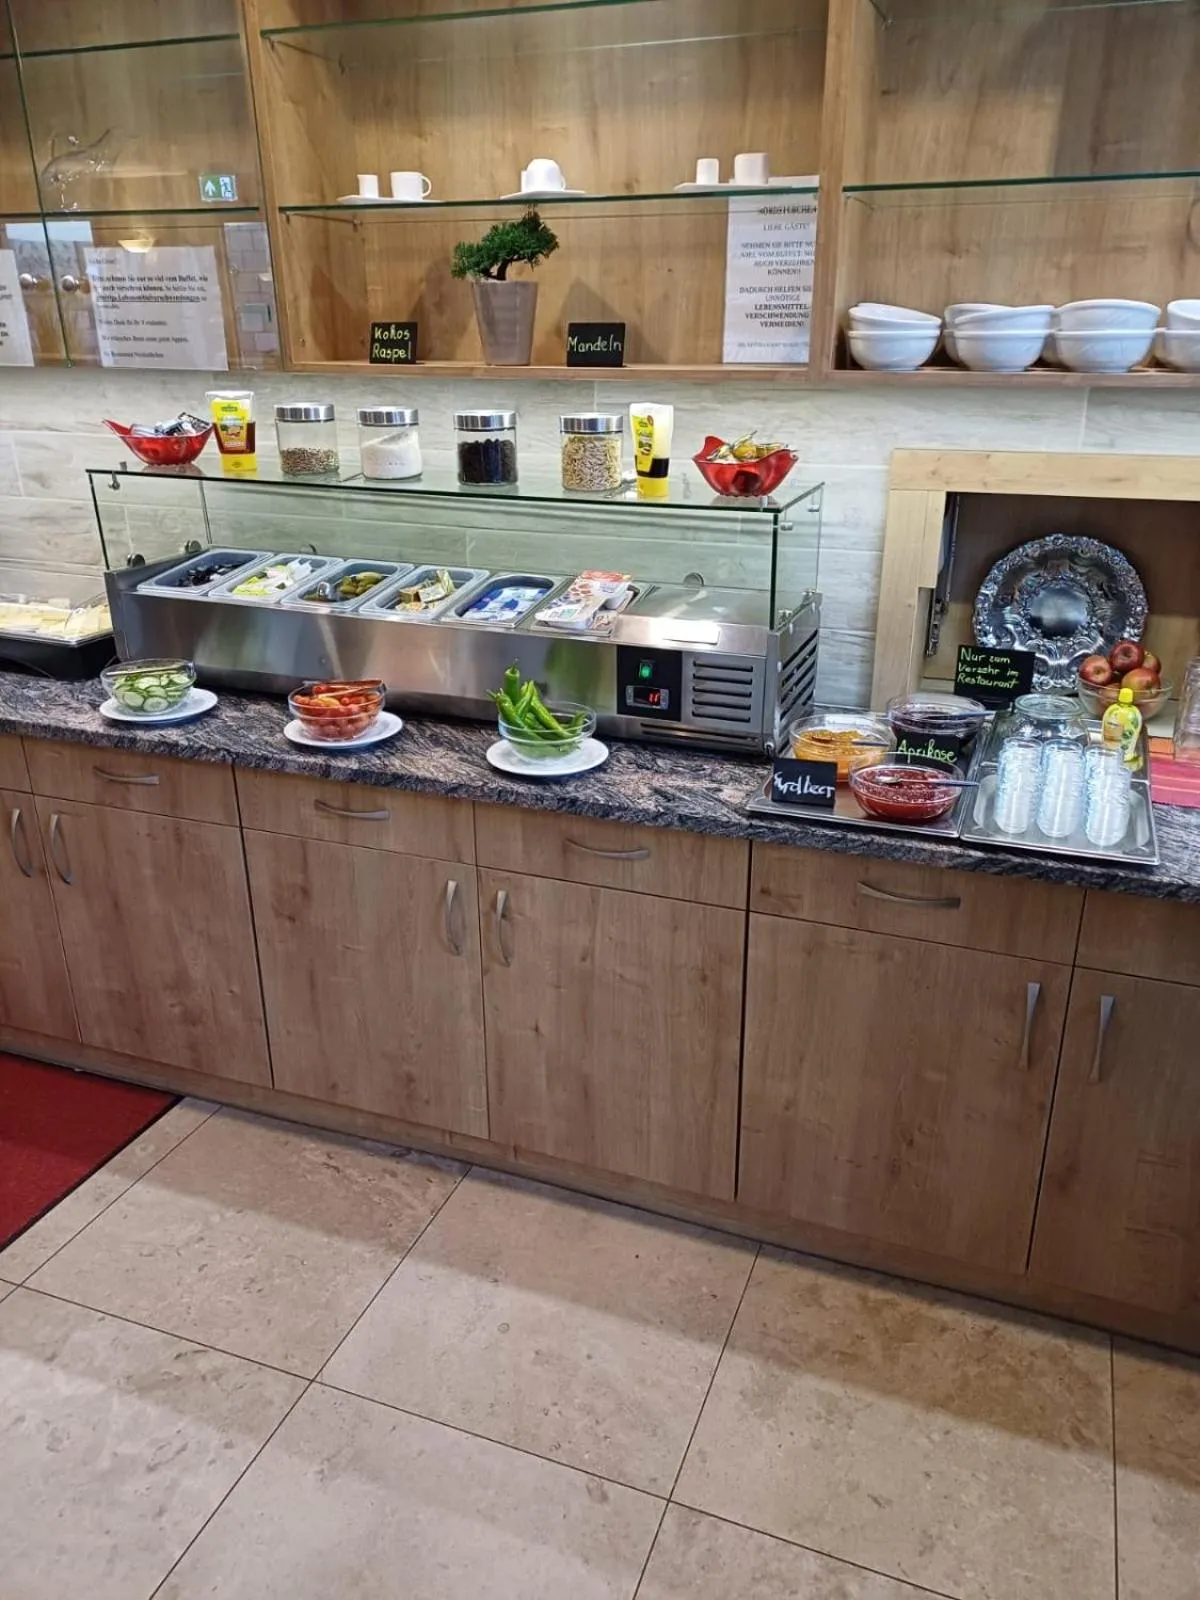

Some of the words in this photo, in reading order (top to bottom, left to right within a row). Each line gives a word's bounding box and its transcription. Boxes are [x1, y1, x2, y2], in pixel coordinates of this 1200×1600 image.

[374, 324, 410, 340] Kokos
[372, 340, 412, 363] Raspel
[568, 334, 622, 352] Mandeln
[960, 647, 986, 661] Nur
[989, 656, 1010, 664] zum
[958, 661, 1001, 675] Verzehr
[1007, 668, 1020, 677] im
[957, 672, 1020, 689] Restaurant
[898, 738, 958, 764] Aprikose
